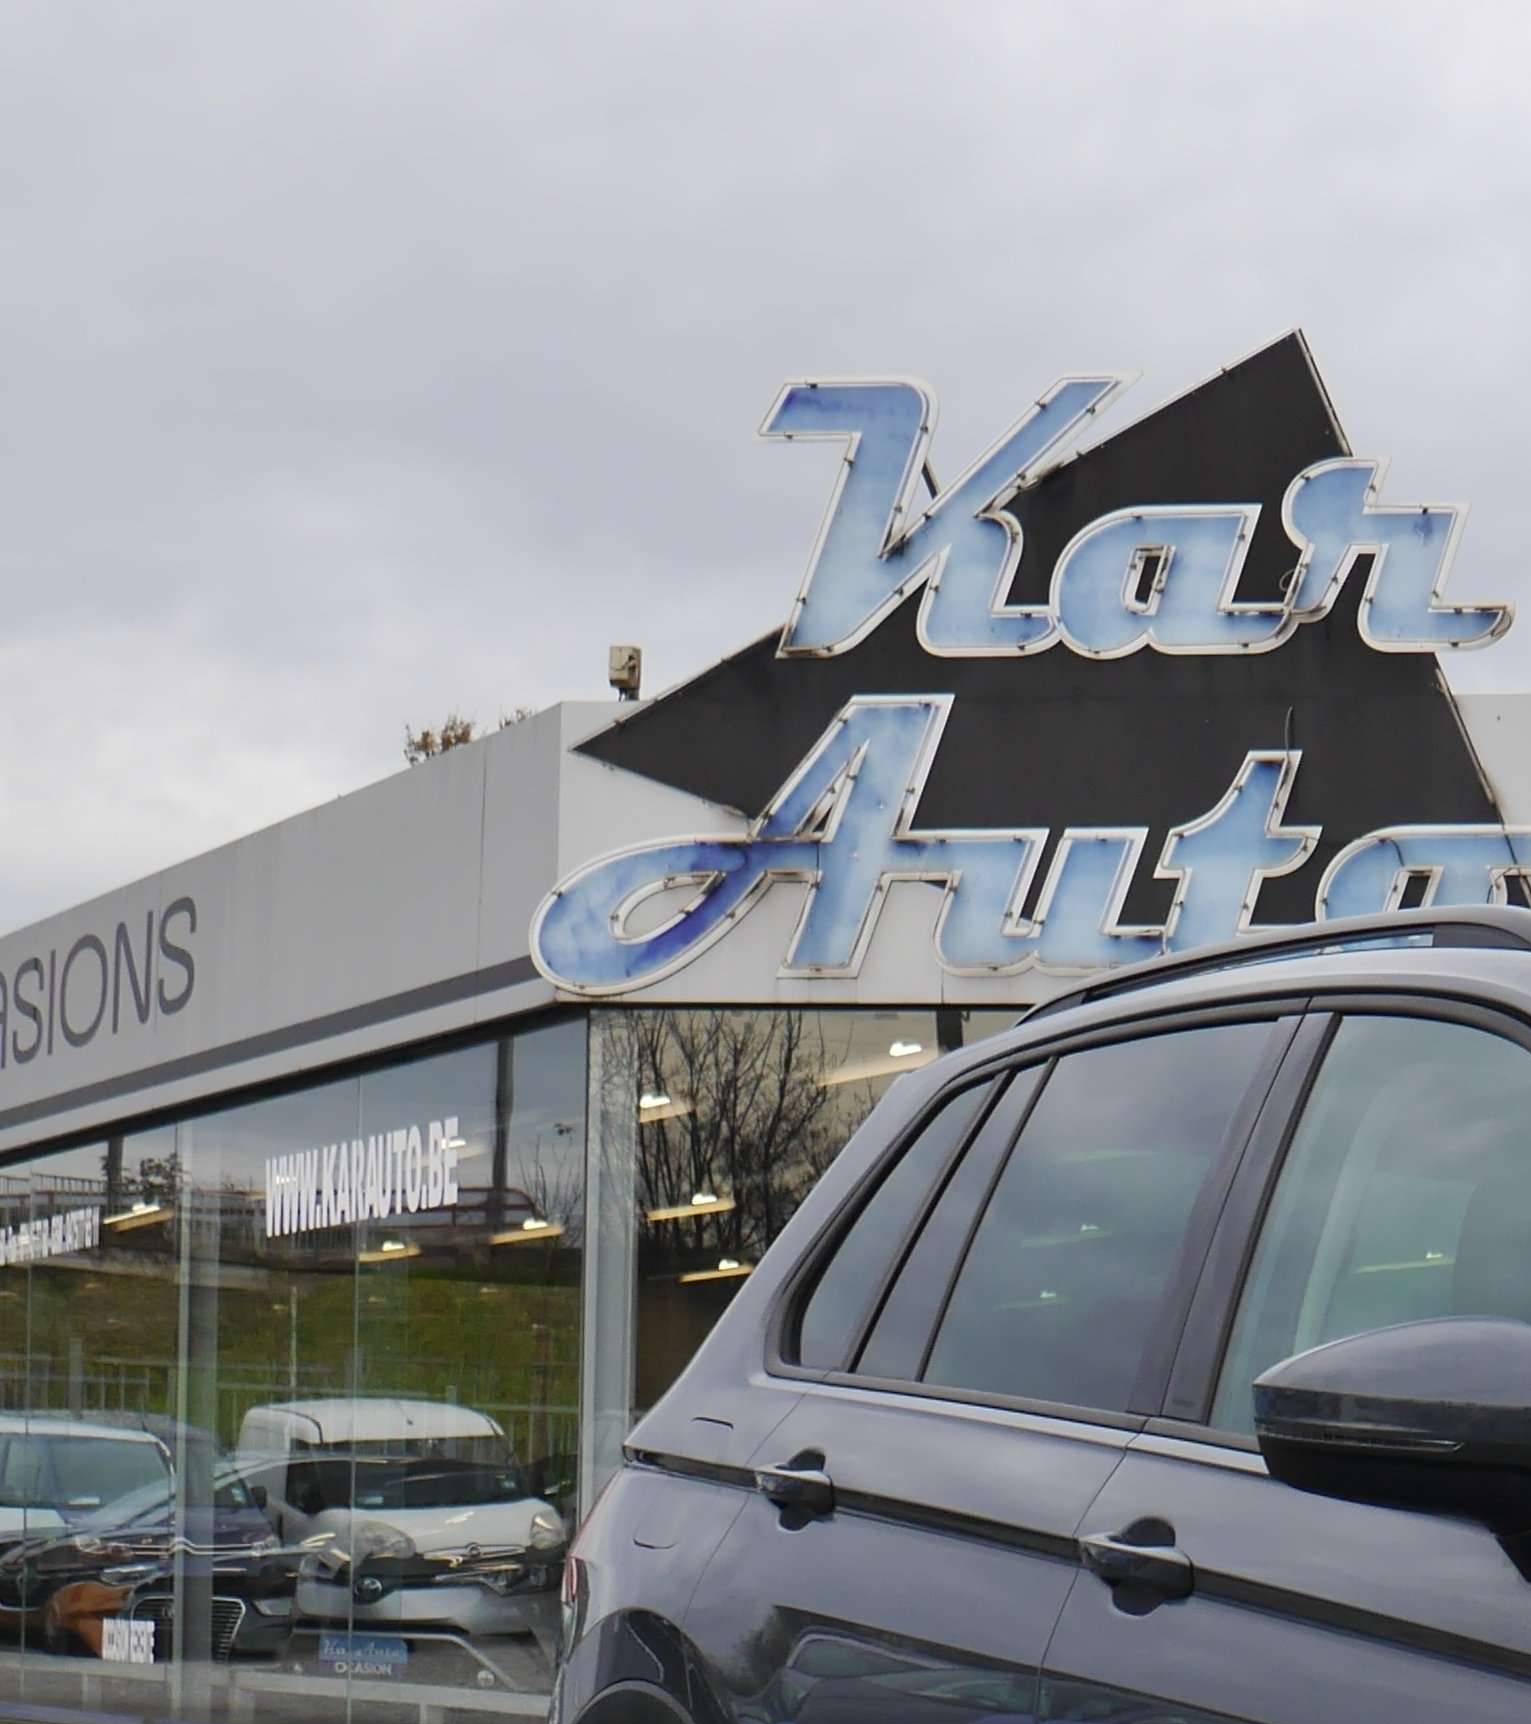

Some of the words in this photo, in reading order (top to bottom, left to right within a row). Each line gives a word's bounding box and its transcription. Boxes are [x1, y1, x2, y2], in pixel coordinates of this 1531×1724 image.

[758, 370, 1515, 659] Kar
[0, 896, 197, 1070] SIONS
[265, 1116, 459, 1238] WWW.KARAUTO.BE
